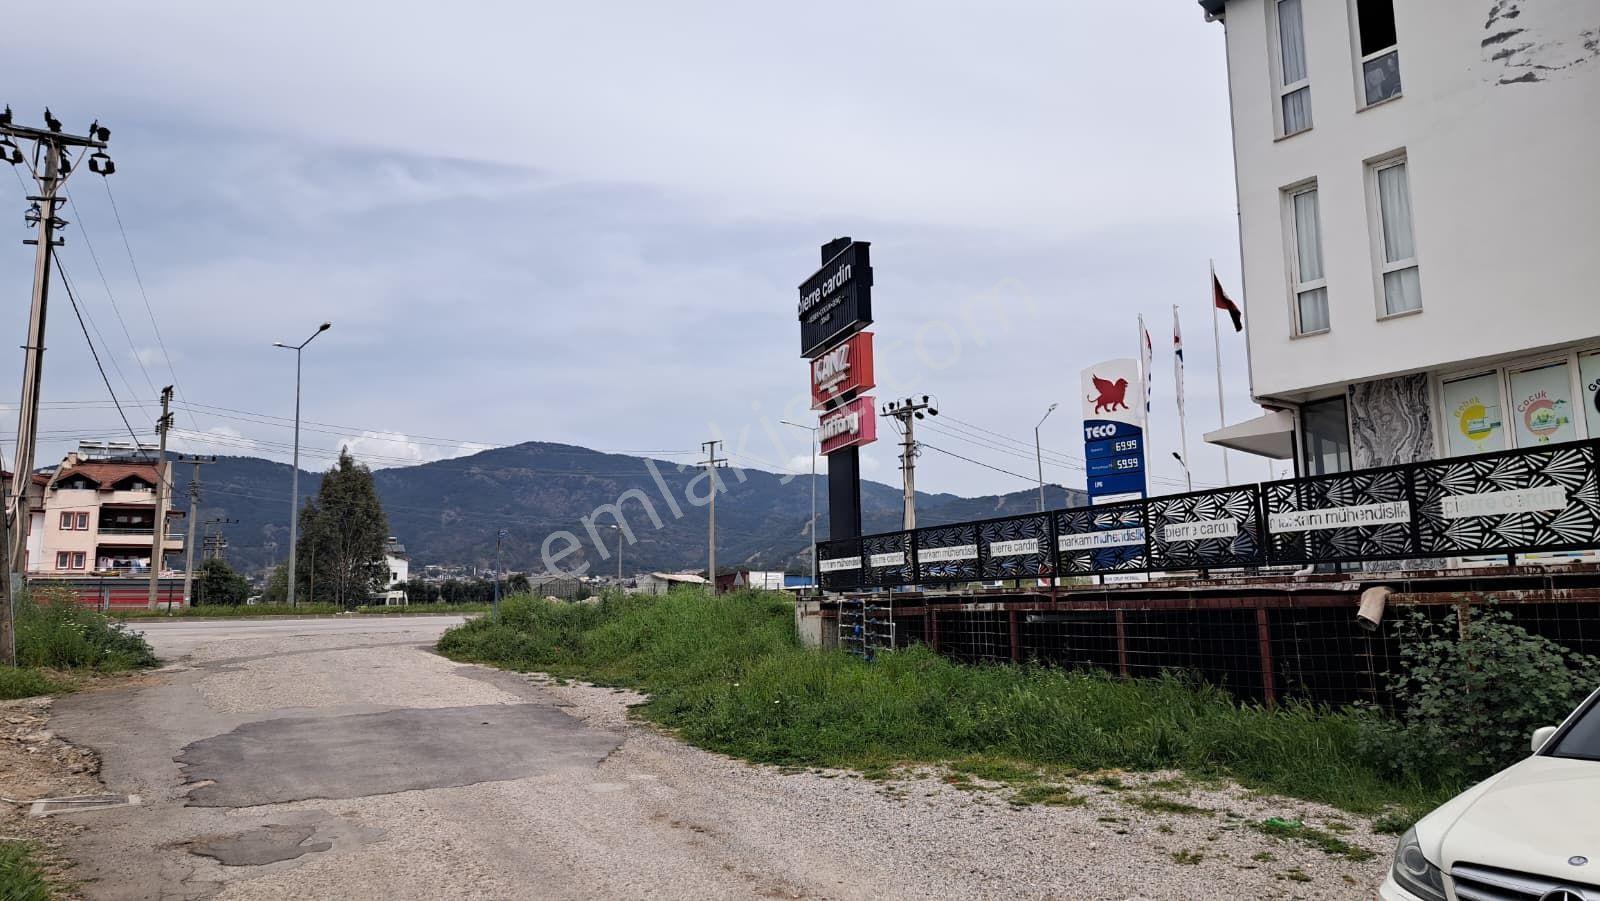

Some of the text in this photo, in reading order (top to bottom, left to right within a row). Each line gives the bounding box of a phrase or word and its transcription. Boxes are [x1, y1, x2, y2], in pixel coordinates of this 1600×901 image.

[822, 263, 852, 298] cardin
[814, 344, 851, 385] KANZ
[1085, 423, 1117, 440] TECO
